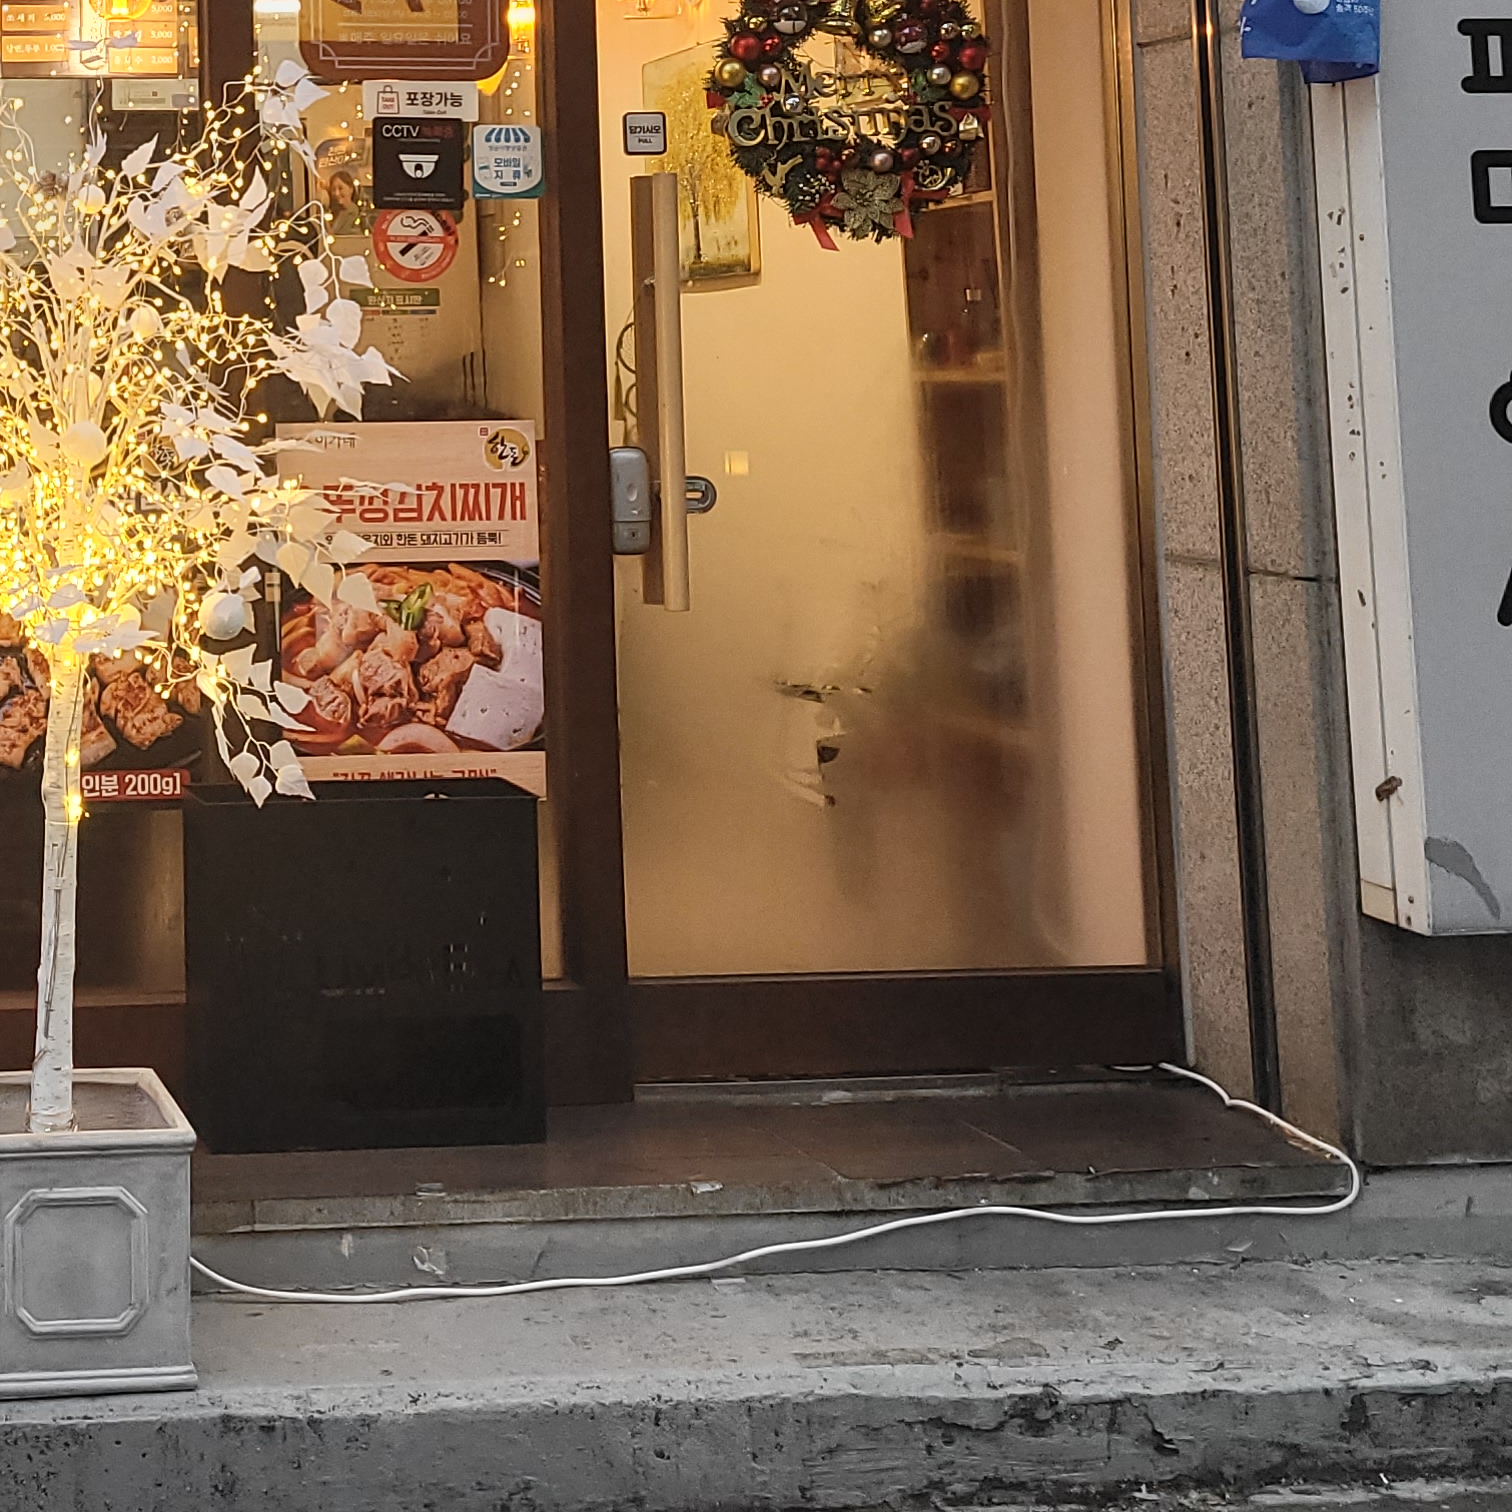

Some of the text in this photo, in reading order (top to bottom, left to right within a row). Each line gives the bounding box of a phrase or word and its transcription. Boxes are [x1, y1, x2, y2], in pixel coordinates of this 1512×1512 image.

[150, 30, 173, 40] 5,000
[405, 91, 464, 108] 포장가능
[381, 124, 420, 138] CCTV
[727, 101, 959, 156] Christmas
[493, 157, 522, 168] 모바일
[396, 532, 419, 547] 한돈
[420, 532, 475, 547] 돼지고기가
